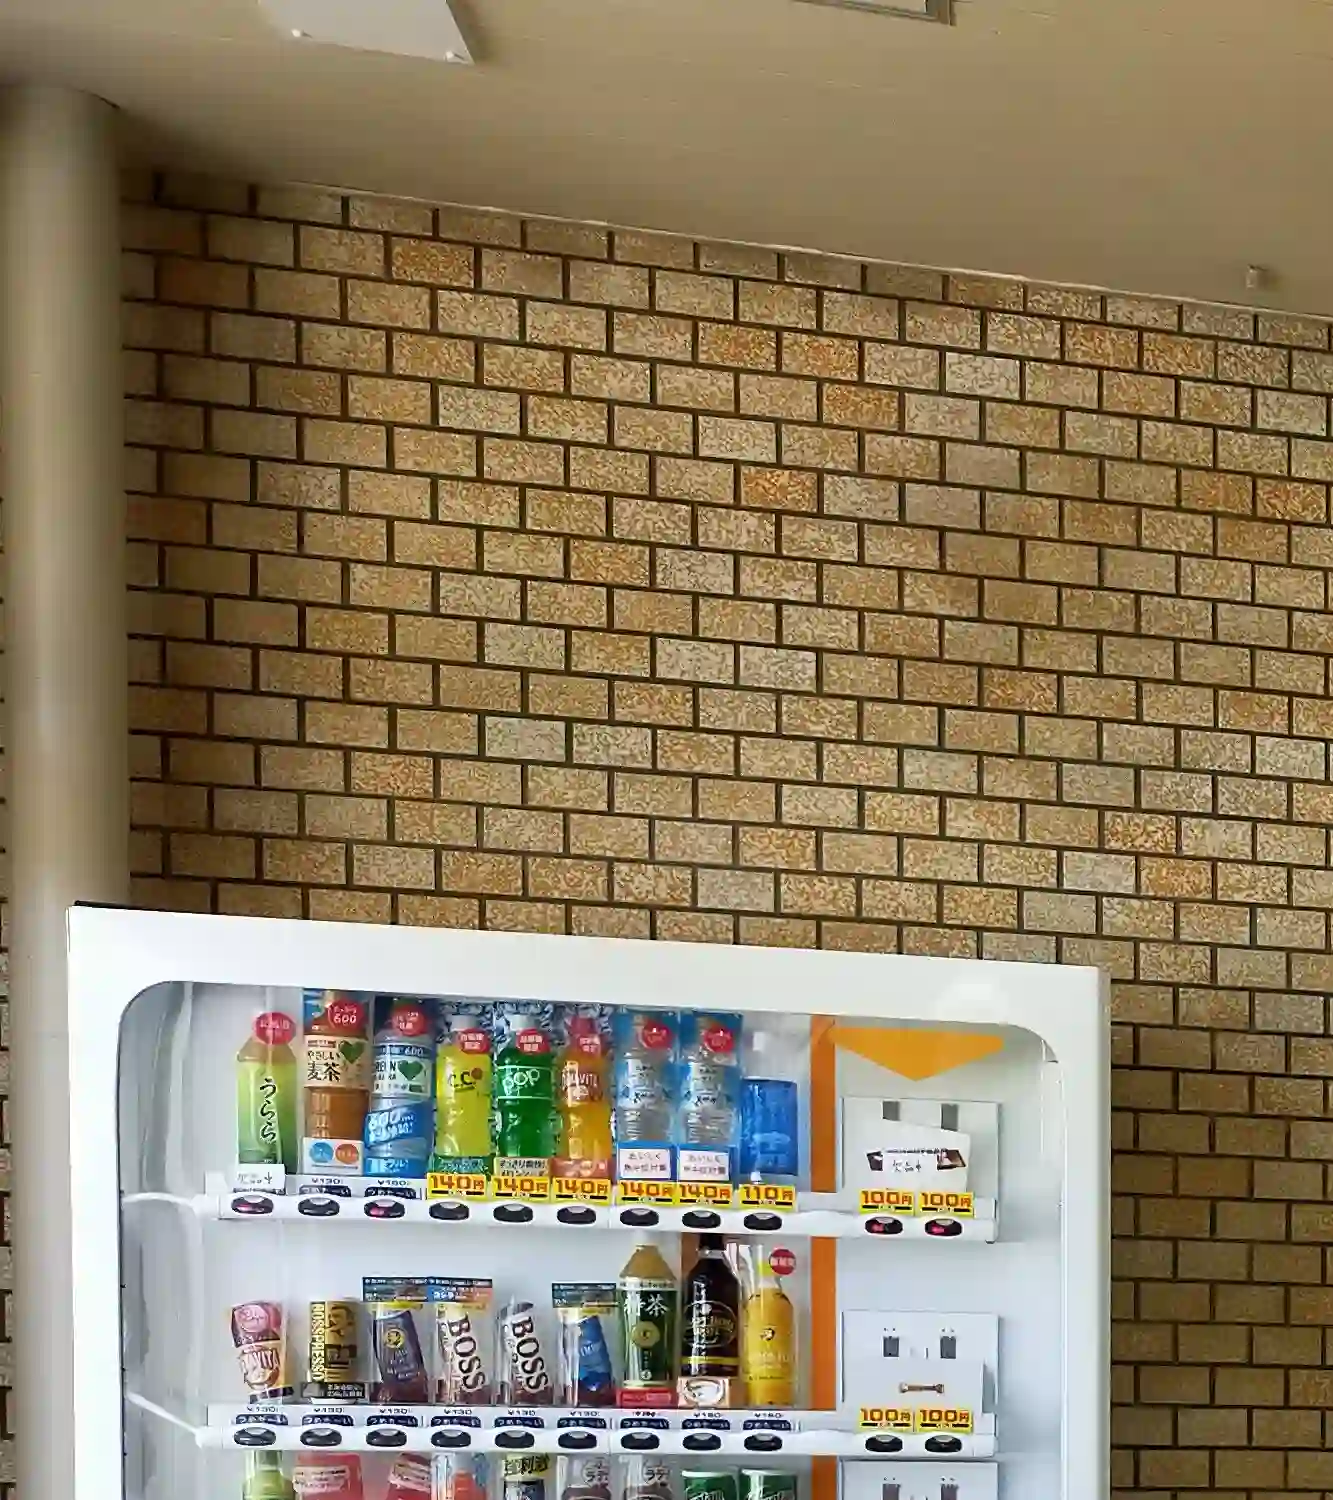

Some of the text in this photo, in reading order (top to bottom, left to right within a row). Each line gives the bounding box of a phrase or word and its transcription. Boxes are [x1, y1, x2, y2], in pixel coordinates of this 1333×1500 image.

[333, 1014, 357, 1025] 600
[306, 1062, 341, 1082] 麦茶
[430, 1175, 485, 1190] 140円
[495, 1177, 549, 1192] 140円
[556, 1179, 609, 1194] 140円
[620, 1182, 673, 1197] 140円
[679, 1184, 731, 1199] 140円
[743, 1186, 793, 1201] 110円
[861, 1190, 912, 1205] 100円
[921, 1192, 972, 1208] 100円
[449, 1311, 487, 1393] BOSS
[511, 1315, 549, 1394] BOSS
[861, 1408, 911, 1422] 100円
[919, 1409, 970, 1423] 100円
